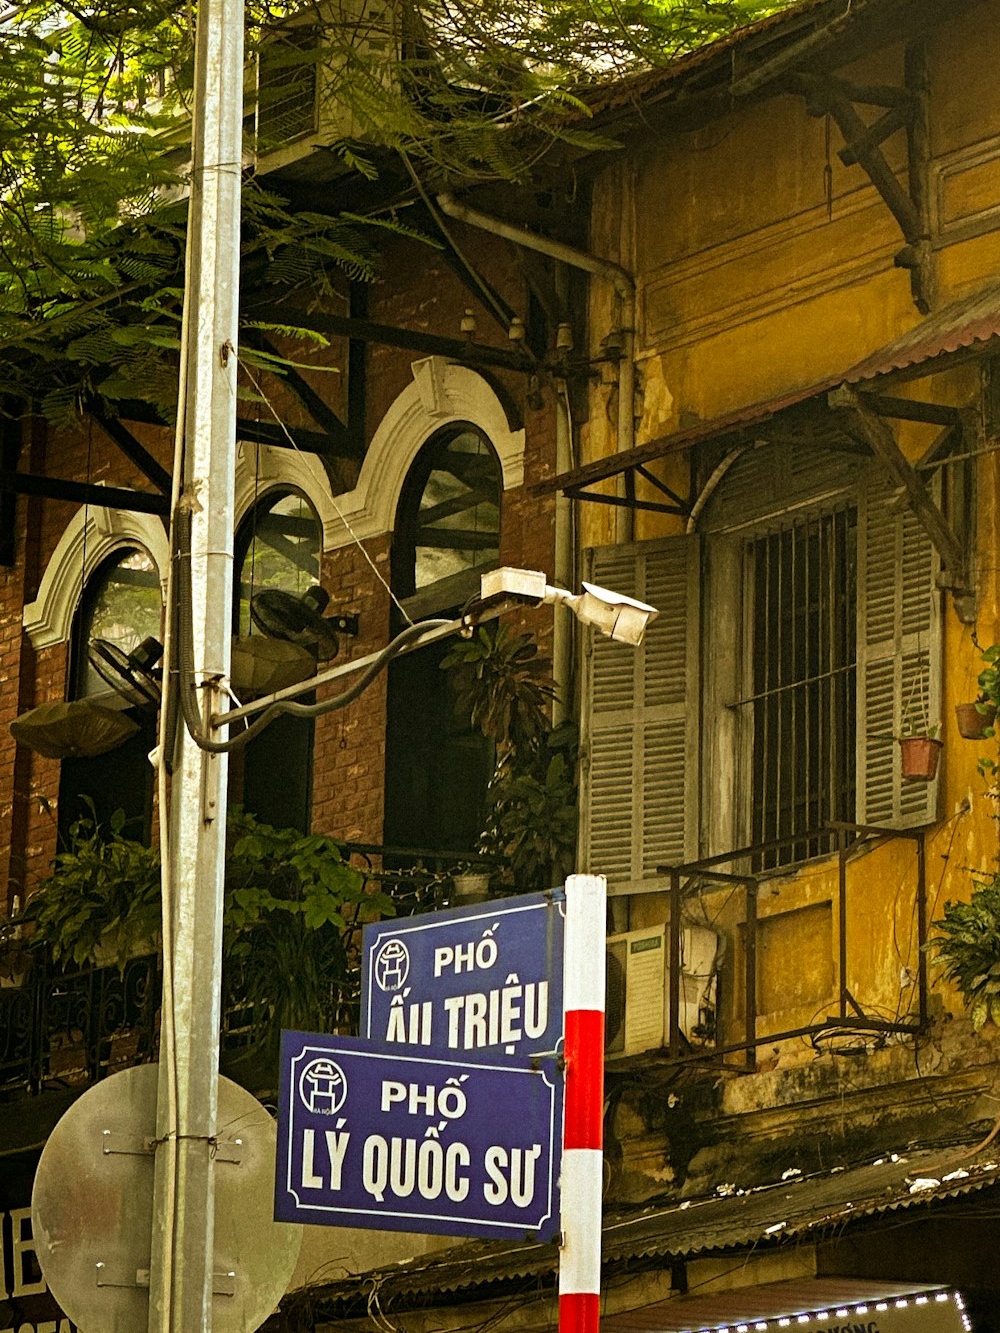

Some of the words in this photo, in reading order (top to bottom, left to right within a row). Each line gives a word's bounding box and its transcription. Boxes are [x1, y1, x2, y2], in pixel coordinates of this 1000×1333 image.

[434, 922, 500, 978] PHỐ
[444, 973, 549, 1055] TRIỆU
[381, 1074, 469, 1119] PHỐ
[302, 1118, 351, 1191] LÝ
[362, 1121, 470, 1202] QUỐC
[483, 1144, 541, 1208] SƯ
